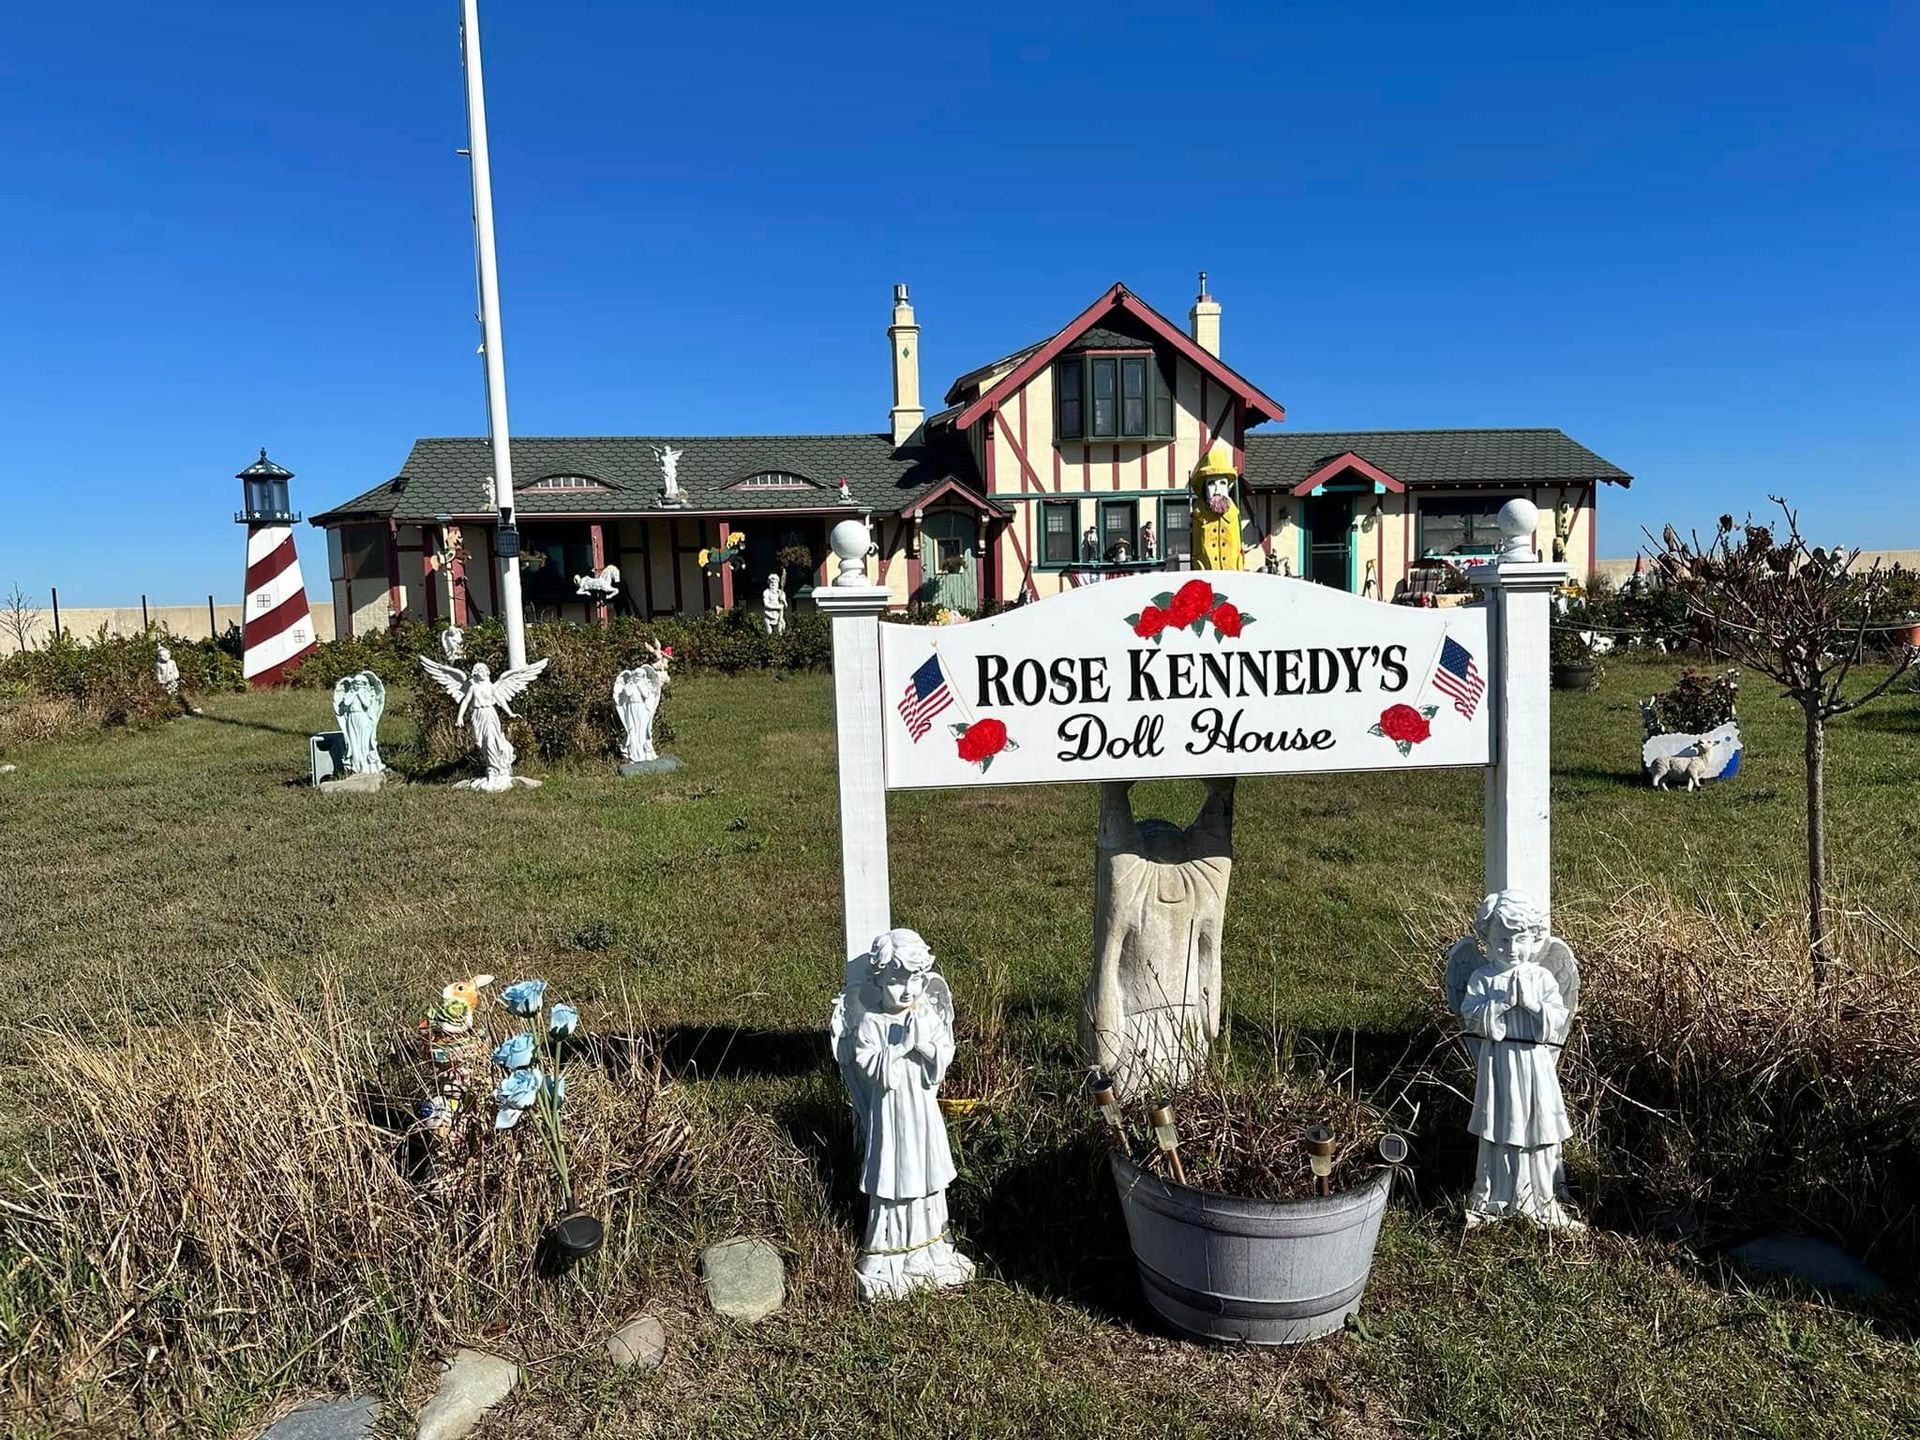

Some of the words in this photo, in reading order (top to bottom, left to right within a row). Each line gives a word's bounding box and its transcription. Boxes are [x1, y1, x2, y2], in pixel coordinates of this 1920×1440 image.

[975, 655, 1110, 706] ROSE
[1128, 645, 1408, 701] KENNEDY'S
[1058, 714, 1164, 761] Doll
[1185, 708, 1336, 755] House
